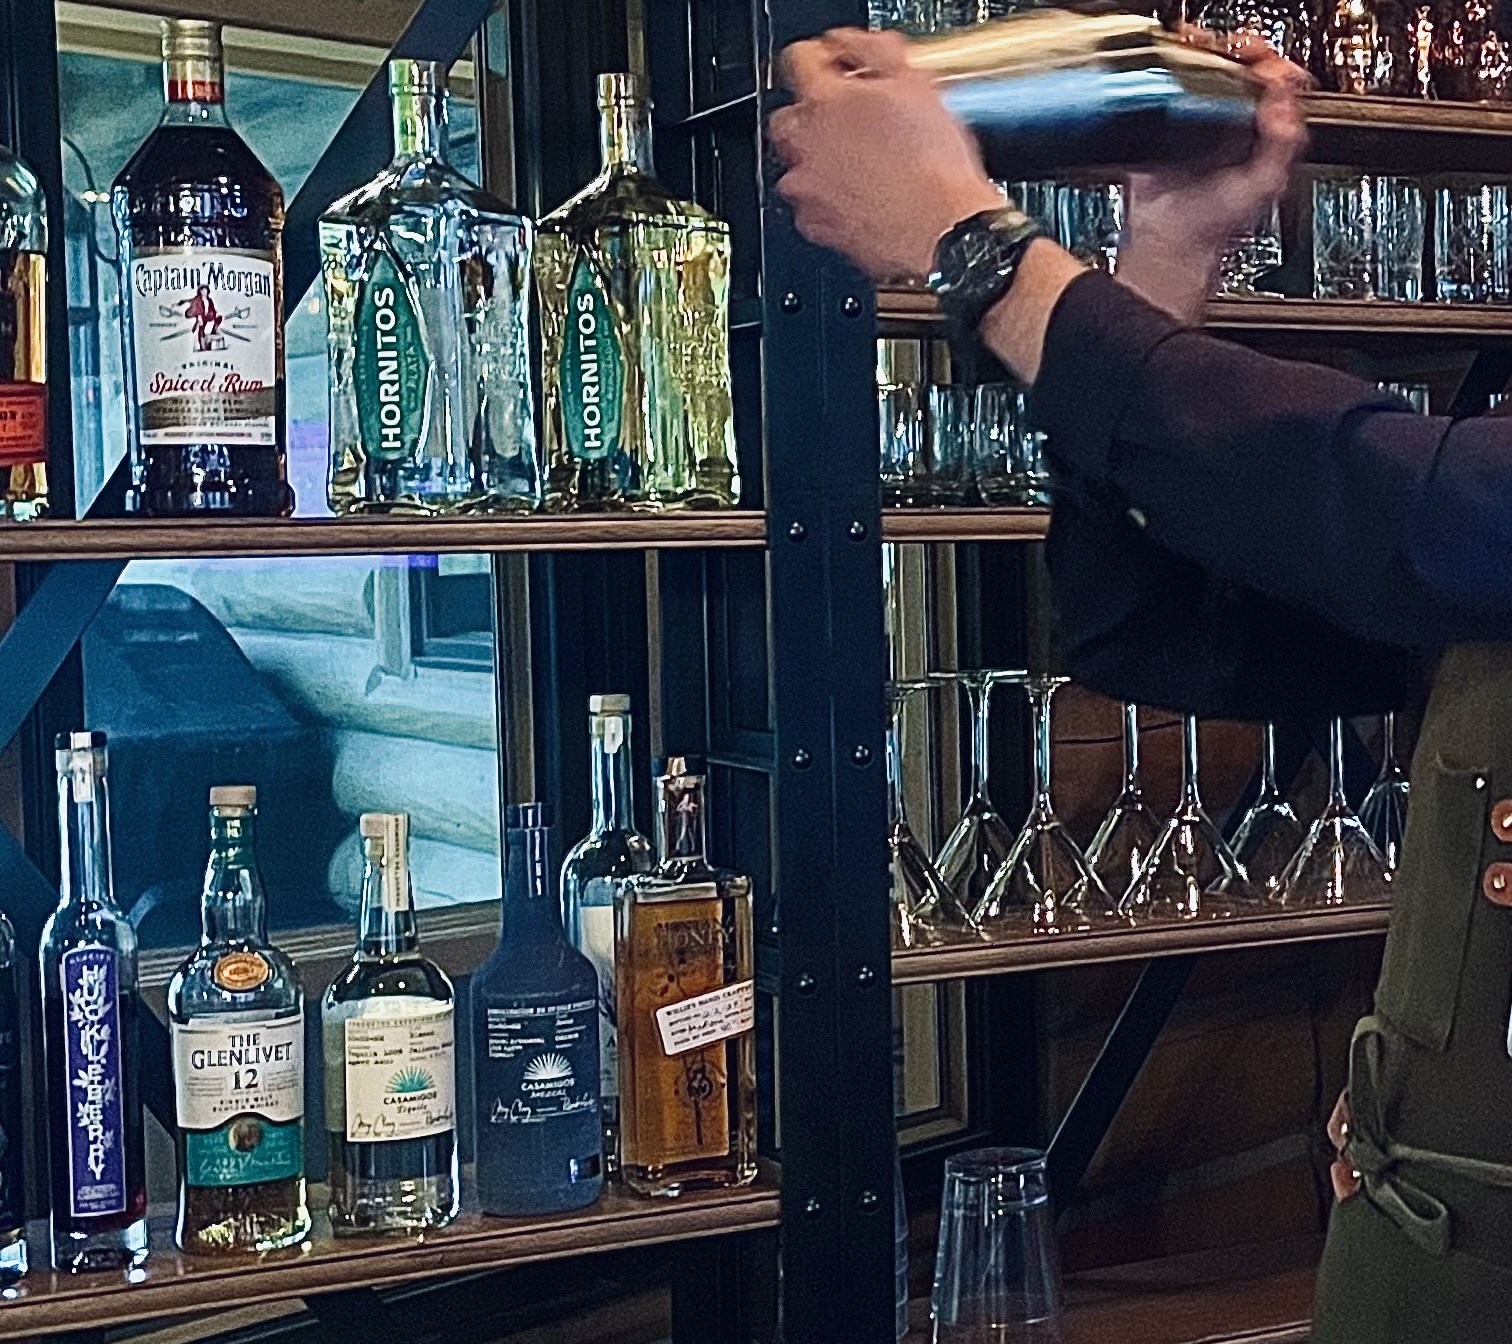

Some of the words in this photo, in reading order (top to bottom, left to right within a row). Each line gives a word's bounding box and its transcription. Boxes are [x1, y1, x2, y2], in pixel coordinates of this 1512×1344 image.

[135, 262, 202, 298] Captain
[204, 262, 272, 299] Morgan
[373, 286, 401, 449] HORNITOS
[576, 292, 602, 449] HORNITOS
[149, 371, 217, 396] Spiced
[218, 372, 264, 396] Rum
[228, 1032, 261, 1048] THE
[191, 1041, 294, 1070] GLENLIVET
[232, 1068, 259, 1090] 12
[383, 1090, 438, 1106] CASAMIGOS
